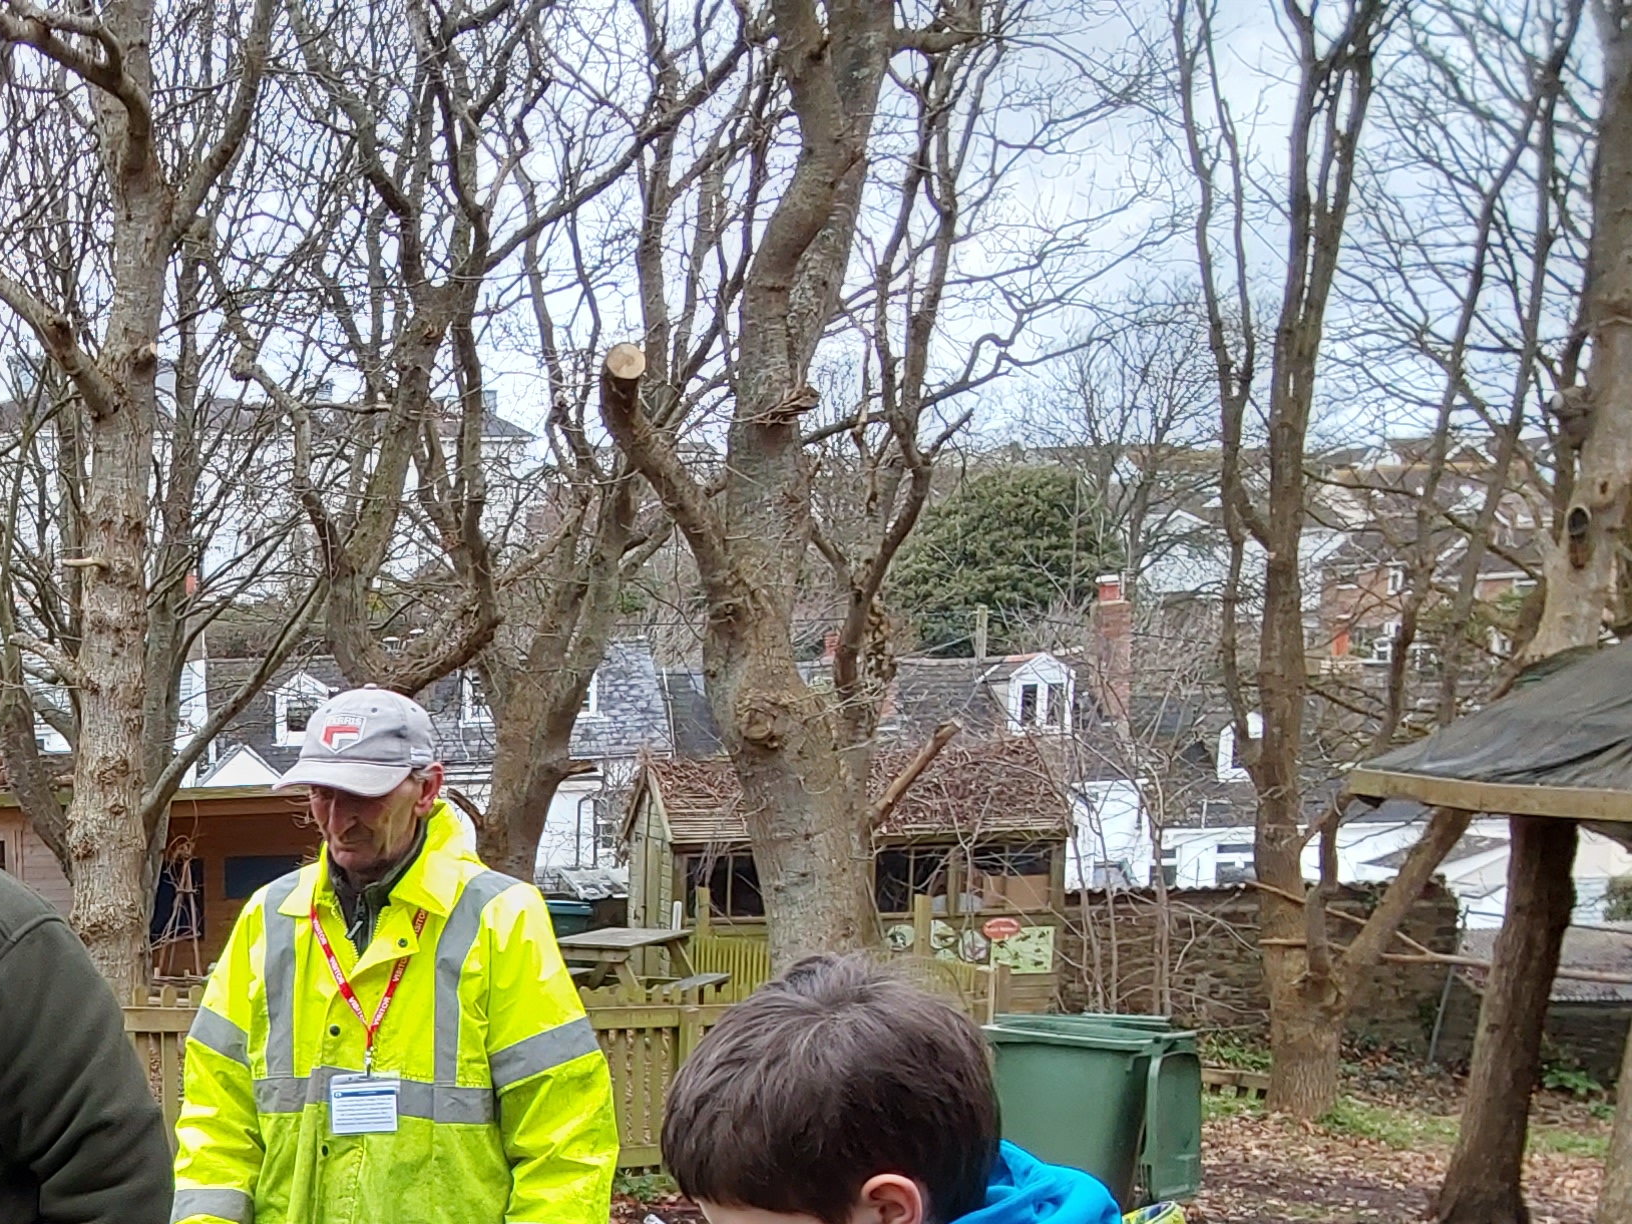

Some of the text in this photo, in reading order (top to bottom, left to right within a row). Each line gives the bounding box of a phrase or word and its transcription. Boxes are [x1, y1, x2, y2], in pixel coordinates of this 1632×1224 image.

[329, 955, 346, 985] VISITOR
[392, 957, 408, 982] VISITO
[373, 996, 391, 1025] VISITOR
